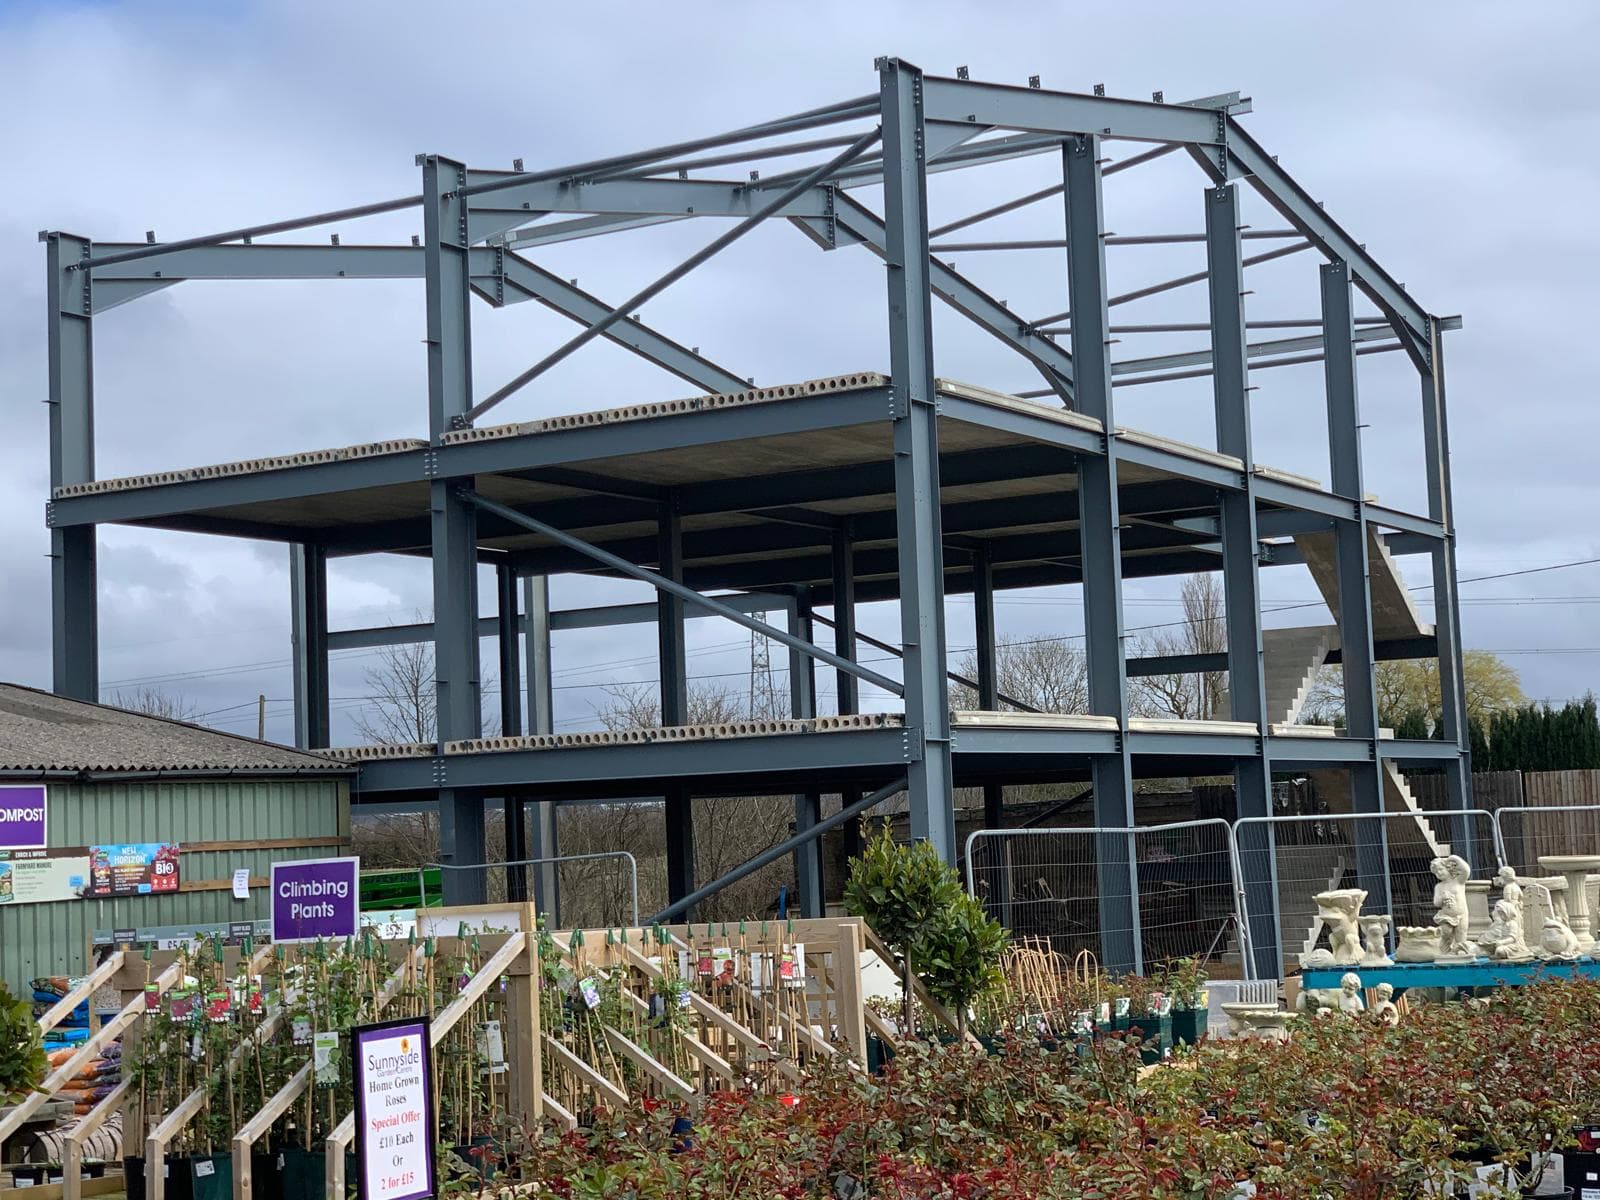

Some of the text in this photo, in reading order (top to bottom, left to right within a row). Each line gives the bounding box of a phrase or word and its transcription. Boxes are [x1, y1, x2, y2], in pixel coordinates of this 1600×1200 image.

[0, 808, 43, 822] OMPOST
[280, 880, 348, 898] Climbing
[291, 902, 334, 919] Plants
[368, 1048, 420, 1072] Sunnyside
[369, 1076, 419, 1093] Home Grown
[385, 1095, 406, 1106] Roses
[371, 1110, 421, 1132] Special Offer
[380, 1132, 414, 1148] £10 Each
[392, 1155, 404, 1166] Or
[382, 1172, 414, 1190] 2 for £15
